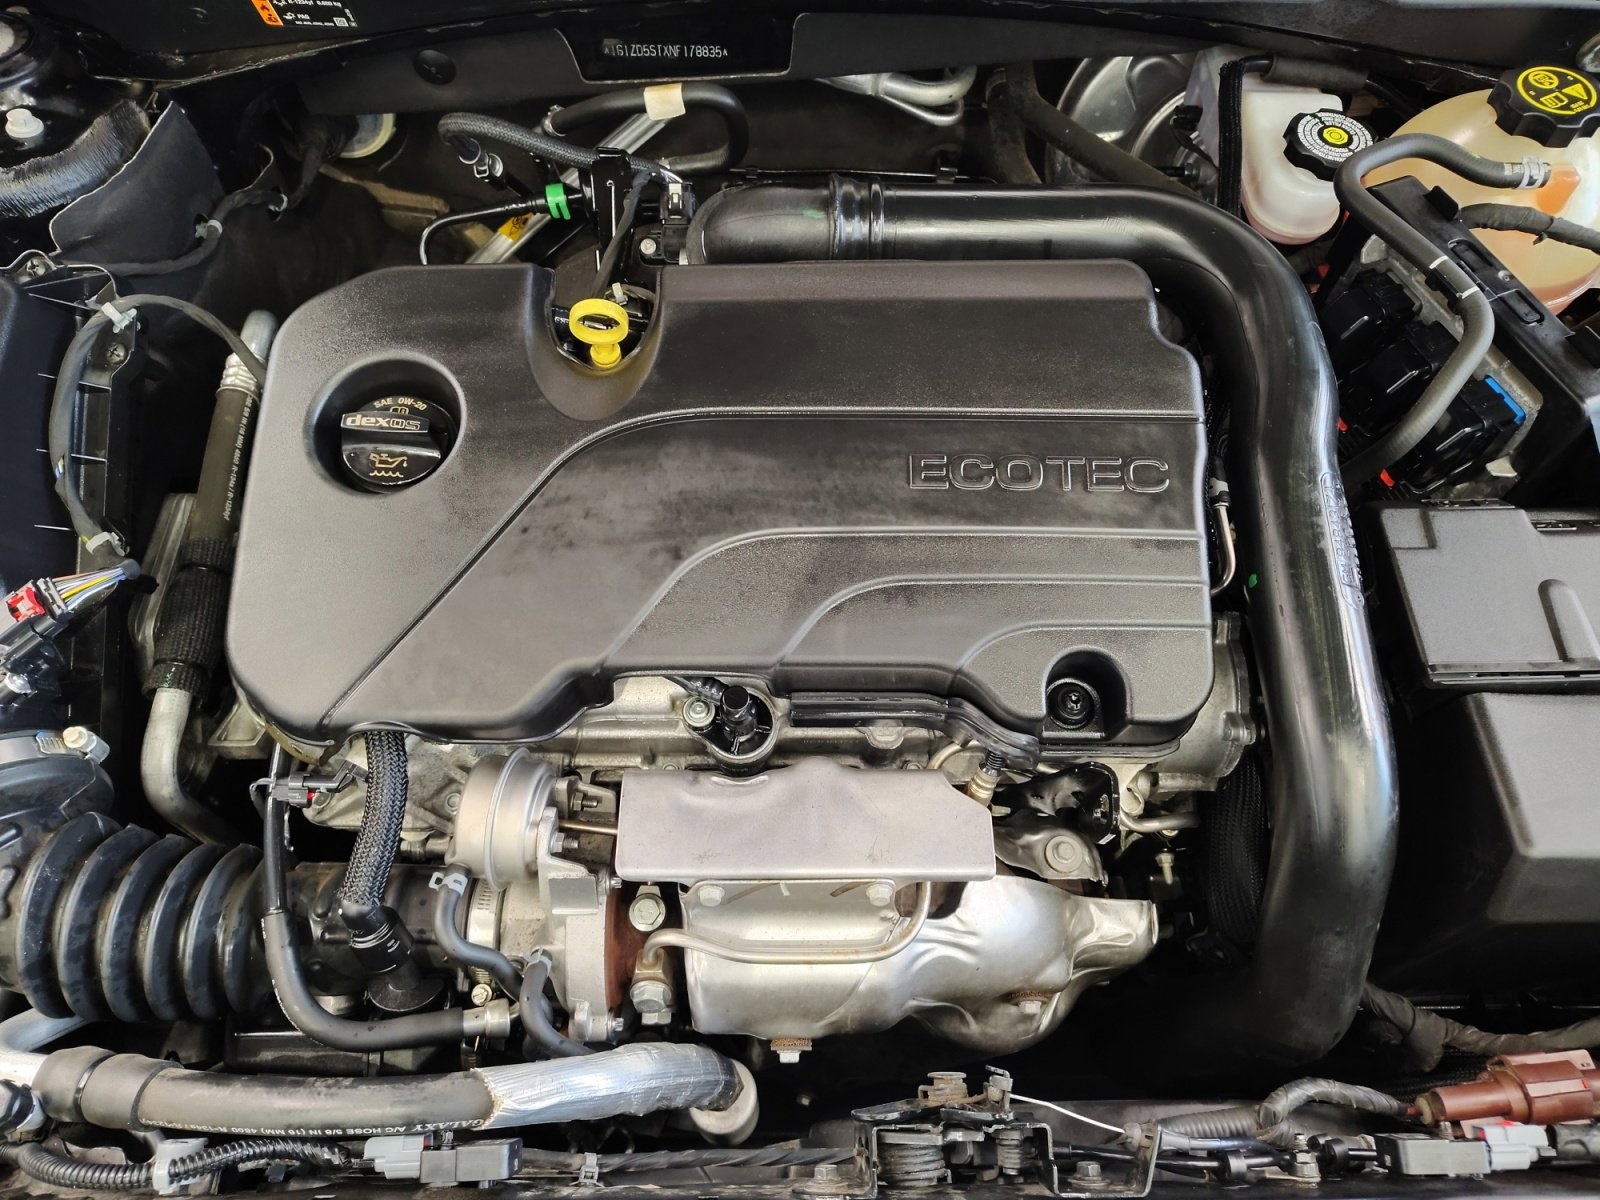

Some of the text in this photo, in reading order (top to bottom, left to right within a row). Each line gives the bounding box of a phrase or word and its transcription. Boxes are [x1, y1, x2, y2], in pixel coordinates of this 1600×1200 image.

[373, 397, 428, 411] SAE 0W-20
[345, 414, 421, 431] dexos
[908, 453, 1170, 493] ECOTEC
[346, 1127, 382, 1135] HOSE
[412, 1119, 485, 1131] GALAXY
